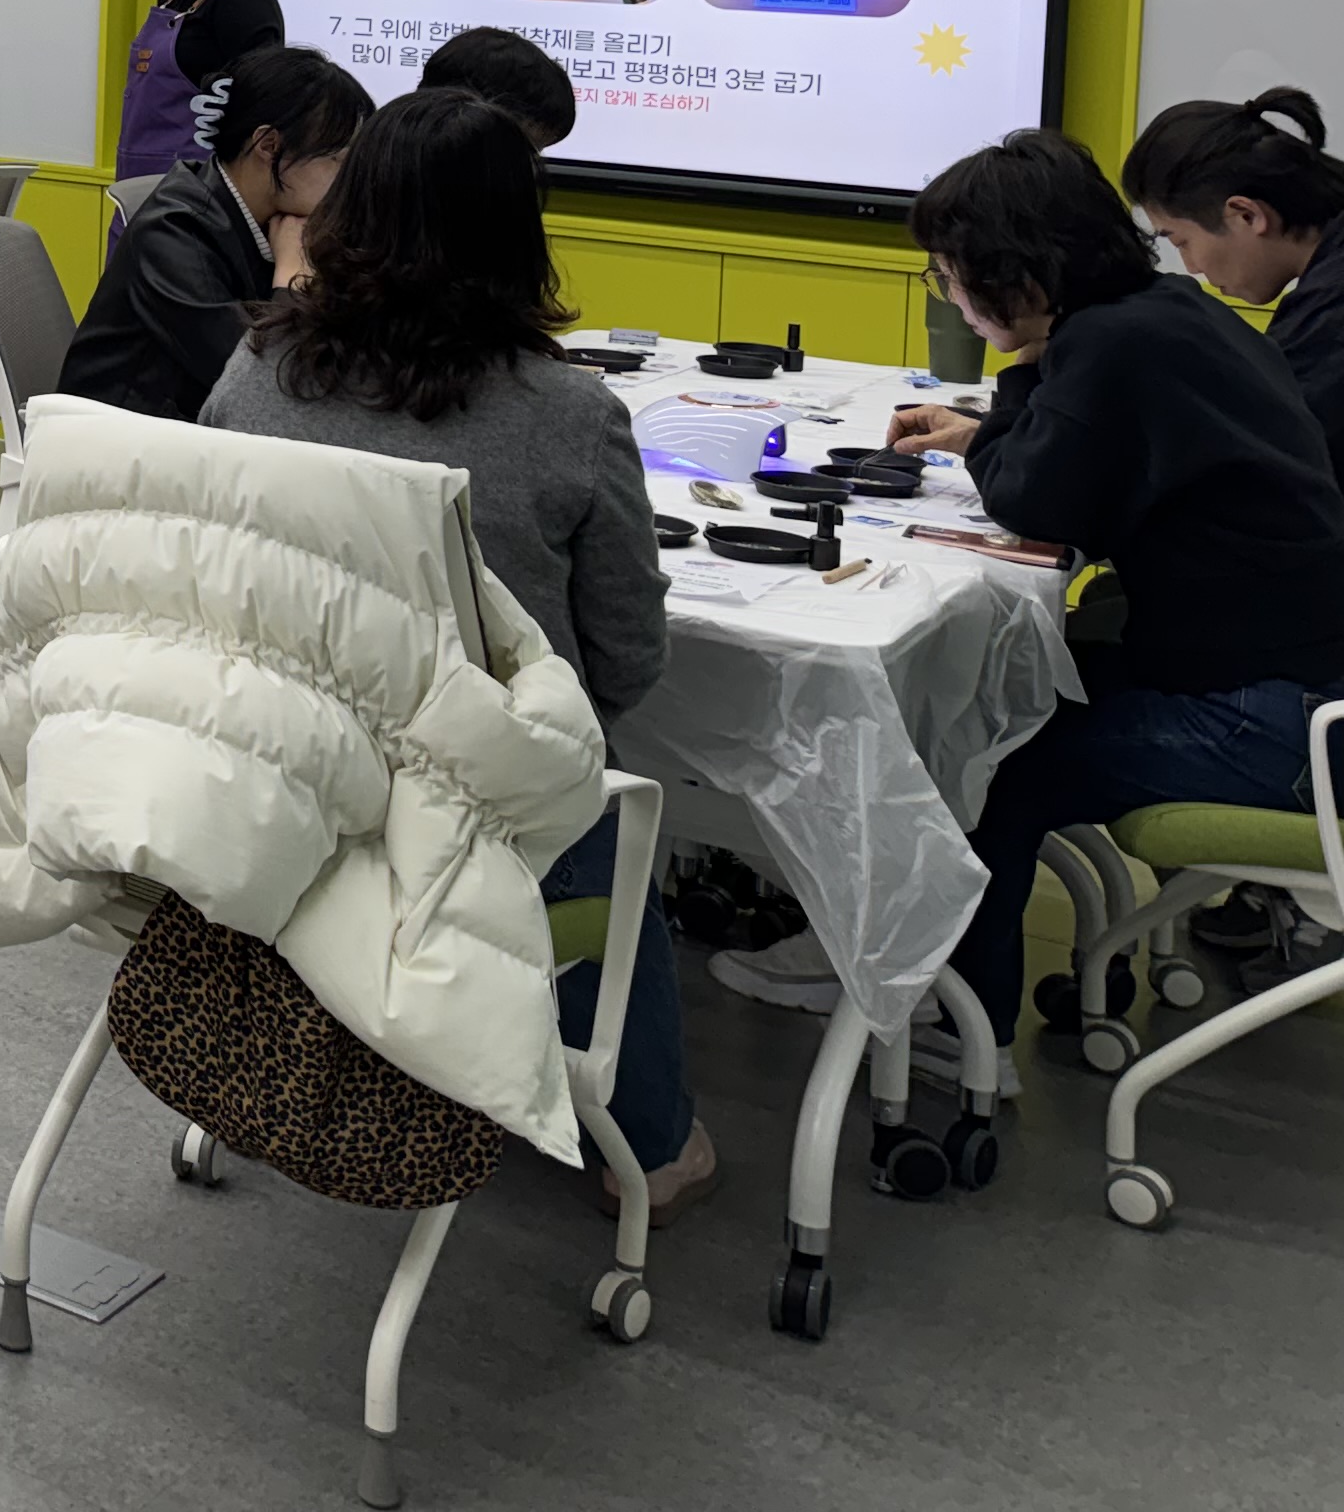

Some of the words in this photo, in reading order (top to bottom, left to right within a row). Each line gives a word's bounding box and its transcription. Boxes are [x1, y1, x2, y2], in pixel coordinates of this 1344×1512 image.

[329, 16, 347, 36] 7.
[353, 17, 373, 37] 그
[380, 18, 421, 41] 위에
[604, 32, 671, 57] 올리기
[352, 44, 391, 65] 많이
[624, 60, 717, 88] 평평하면
[725, 68, 764, 91] 3분
[774, 71, 822, 95] 굽기
[604, 88, 637, 107] 않게
[643, 92, 710, 112] 조심하기
